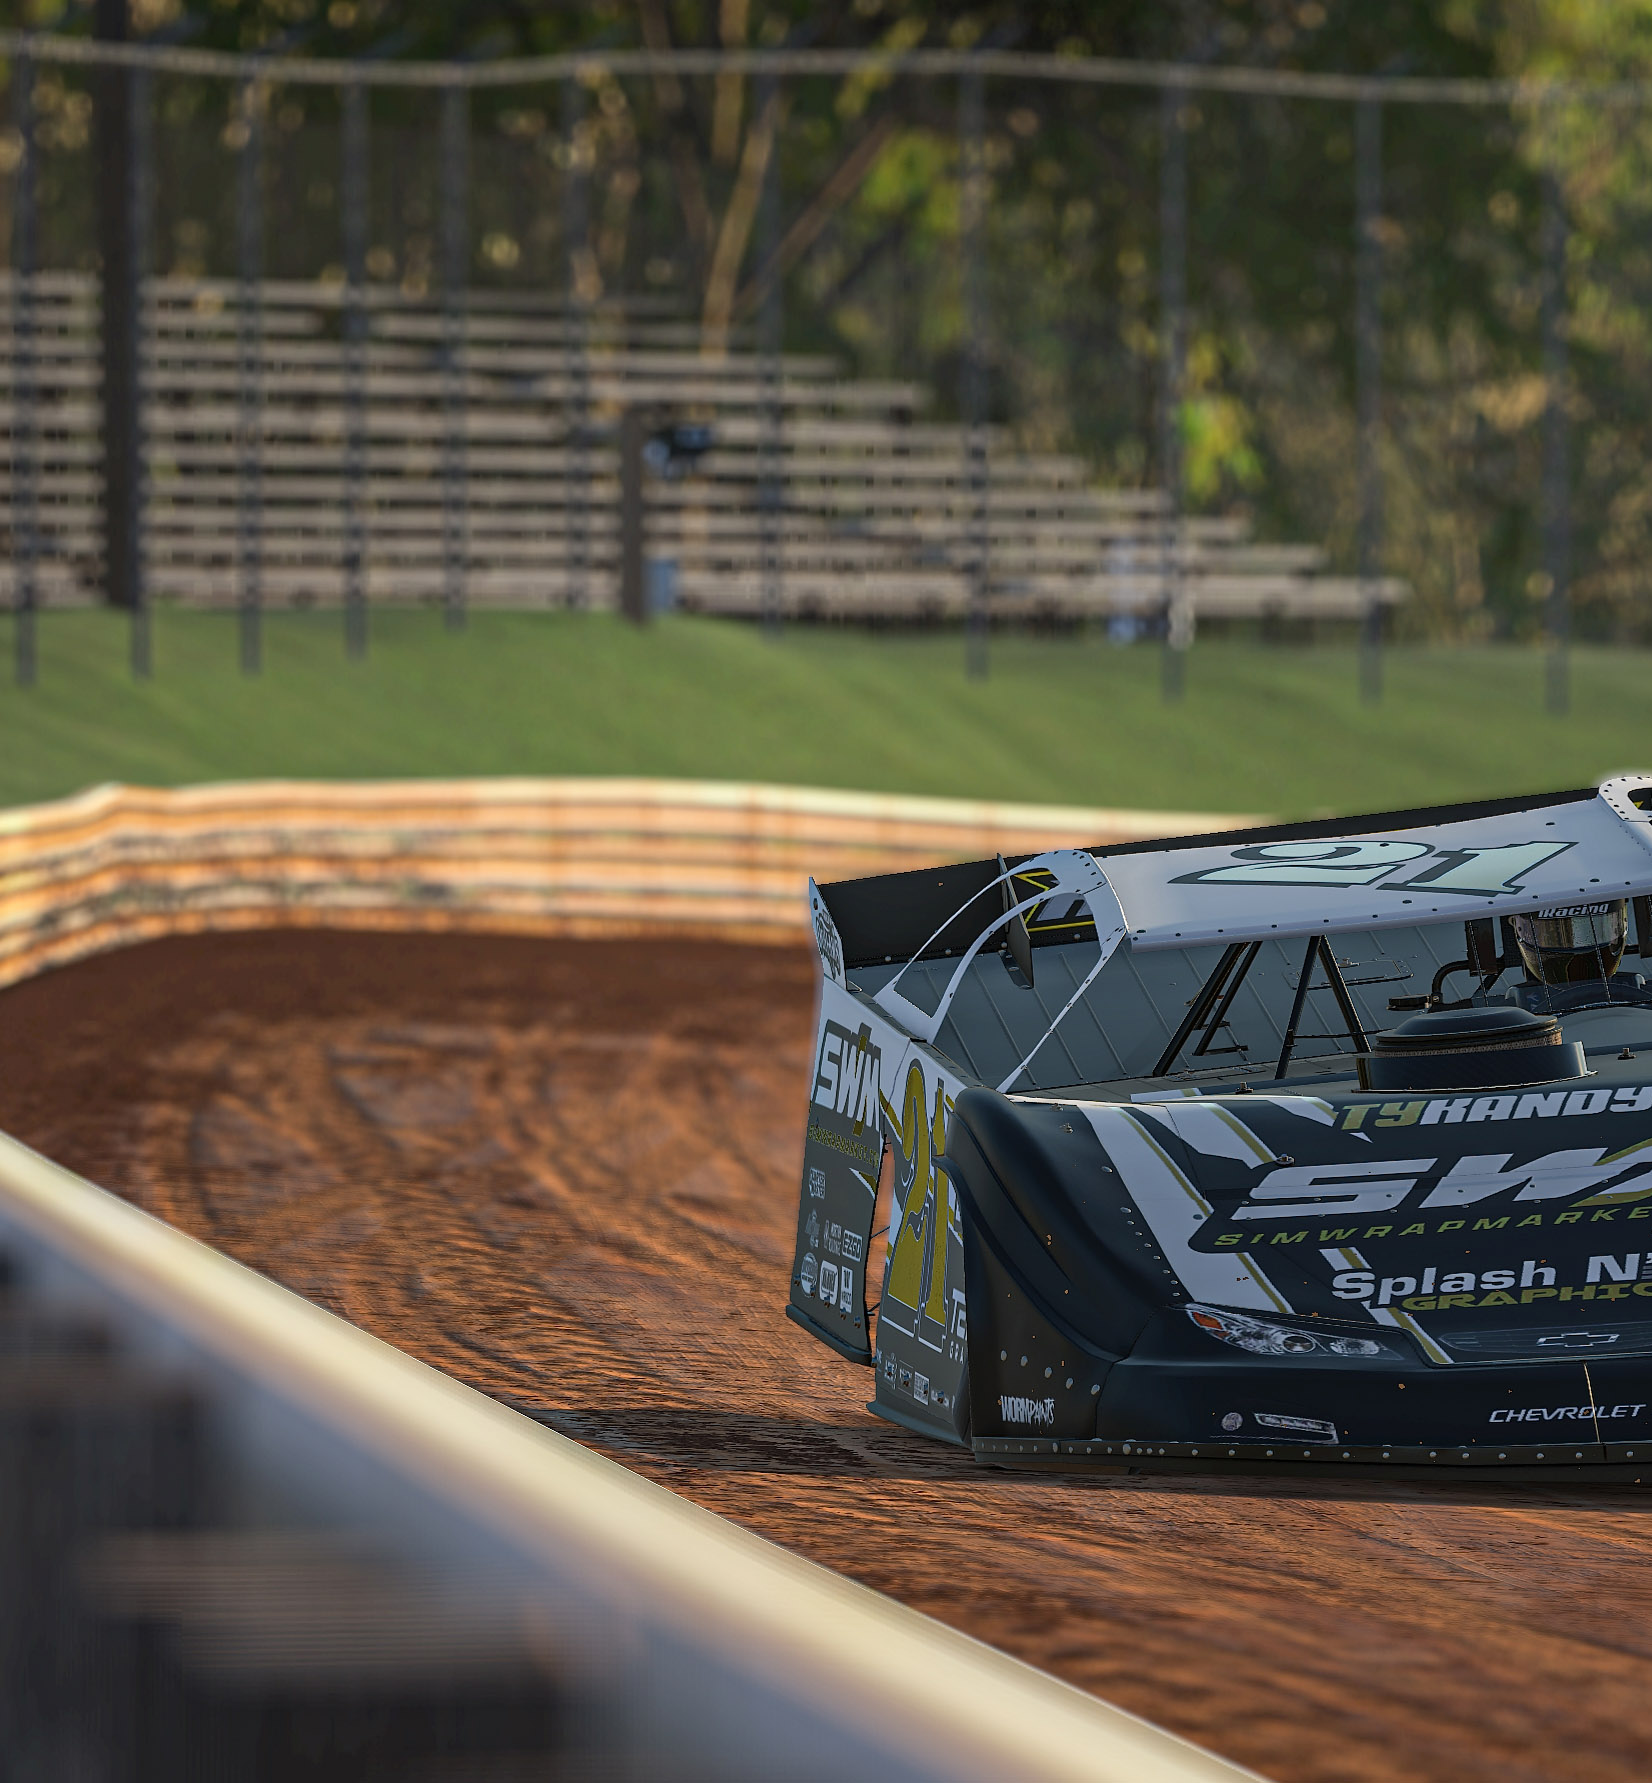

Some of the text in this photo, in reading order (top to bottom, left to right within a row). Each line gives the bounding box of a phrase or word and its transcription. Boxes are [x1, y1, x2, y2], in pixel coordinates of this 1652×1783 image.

[1168, 840, 1579, 897] 21
[814, 1031, 880, 1134] SWM
[884, 1060, 948, 1330] 21
[1331, 1259, 1557, 1307] Splash
[1488, 1403, 1647, 1423] CHEVROLET
